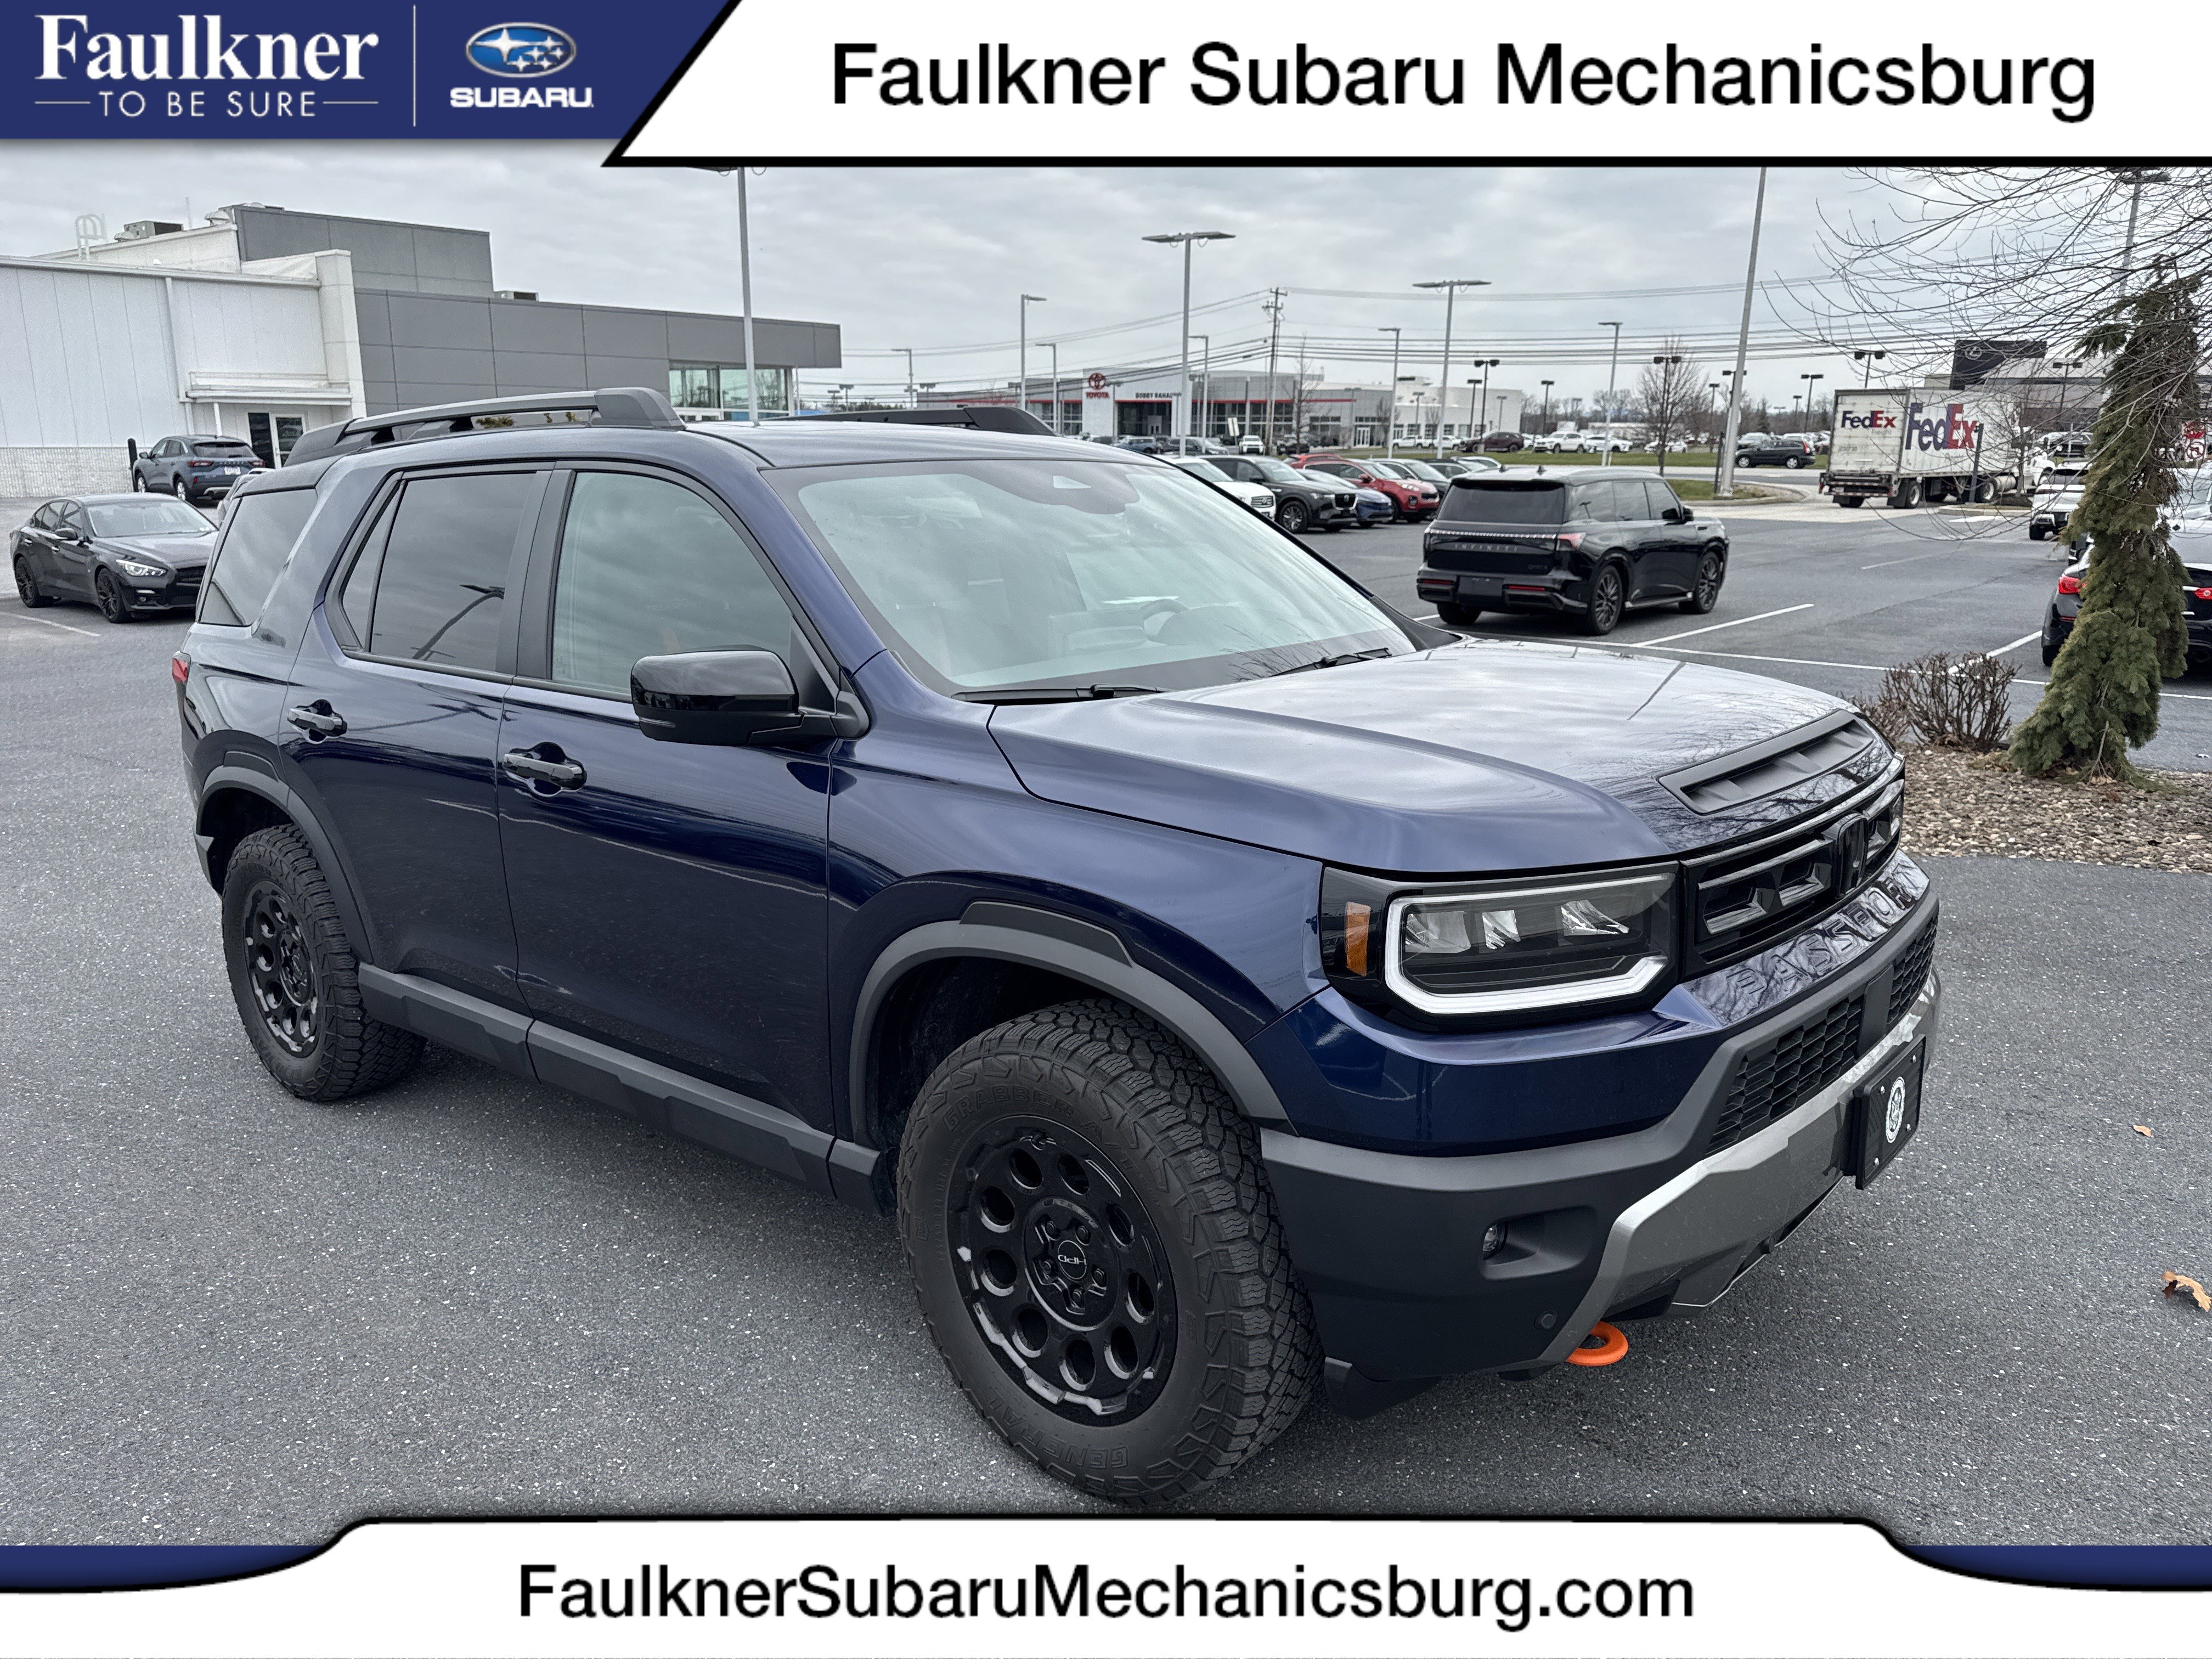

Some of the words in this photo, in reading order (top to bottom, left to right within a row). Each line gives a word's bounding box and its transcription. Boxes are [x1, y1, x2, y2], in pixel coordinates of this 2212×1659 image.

[1841, 410, 1897, 428] FedEx
[1905, 403, 1978, 451] FedEx
[1726, 864, 1921, 1001] PASSPORT
[941, 1085, 1074, 1132] GRABBER
[1057, 1254, 1087, 1266] HPD
[989, 1386, 1128, 1470] GENERAL
